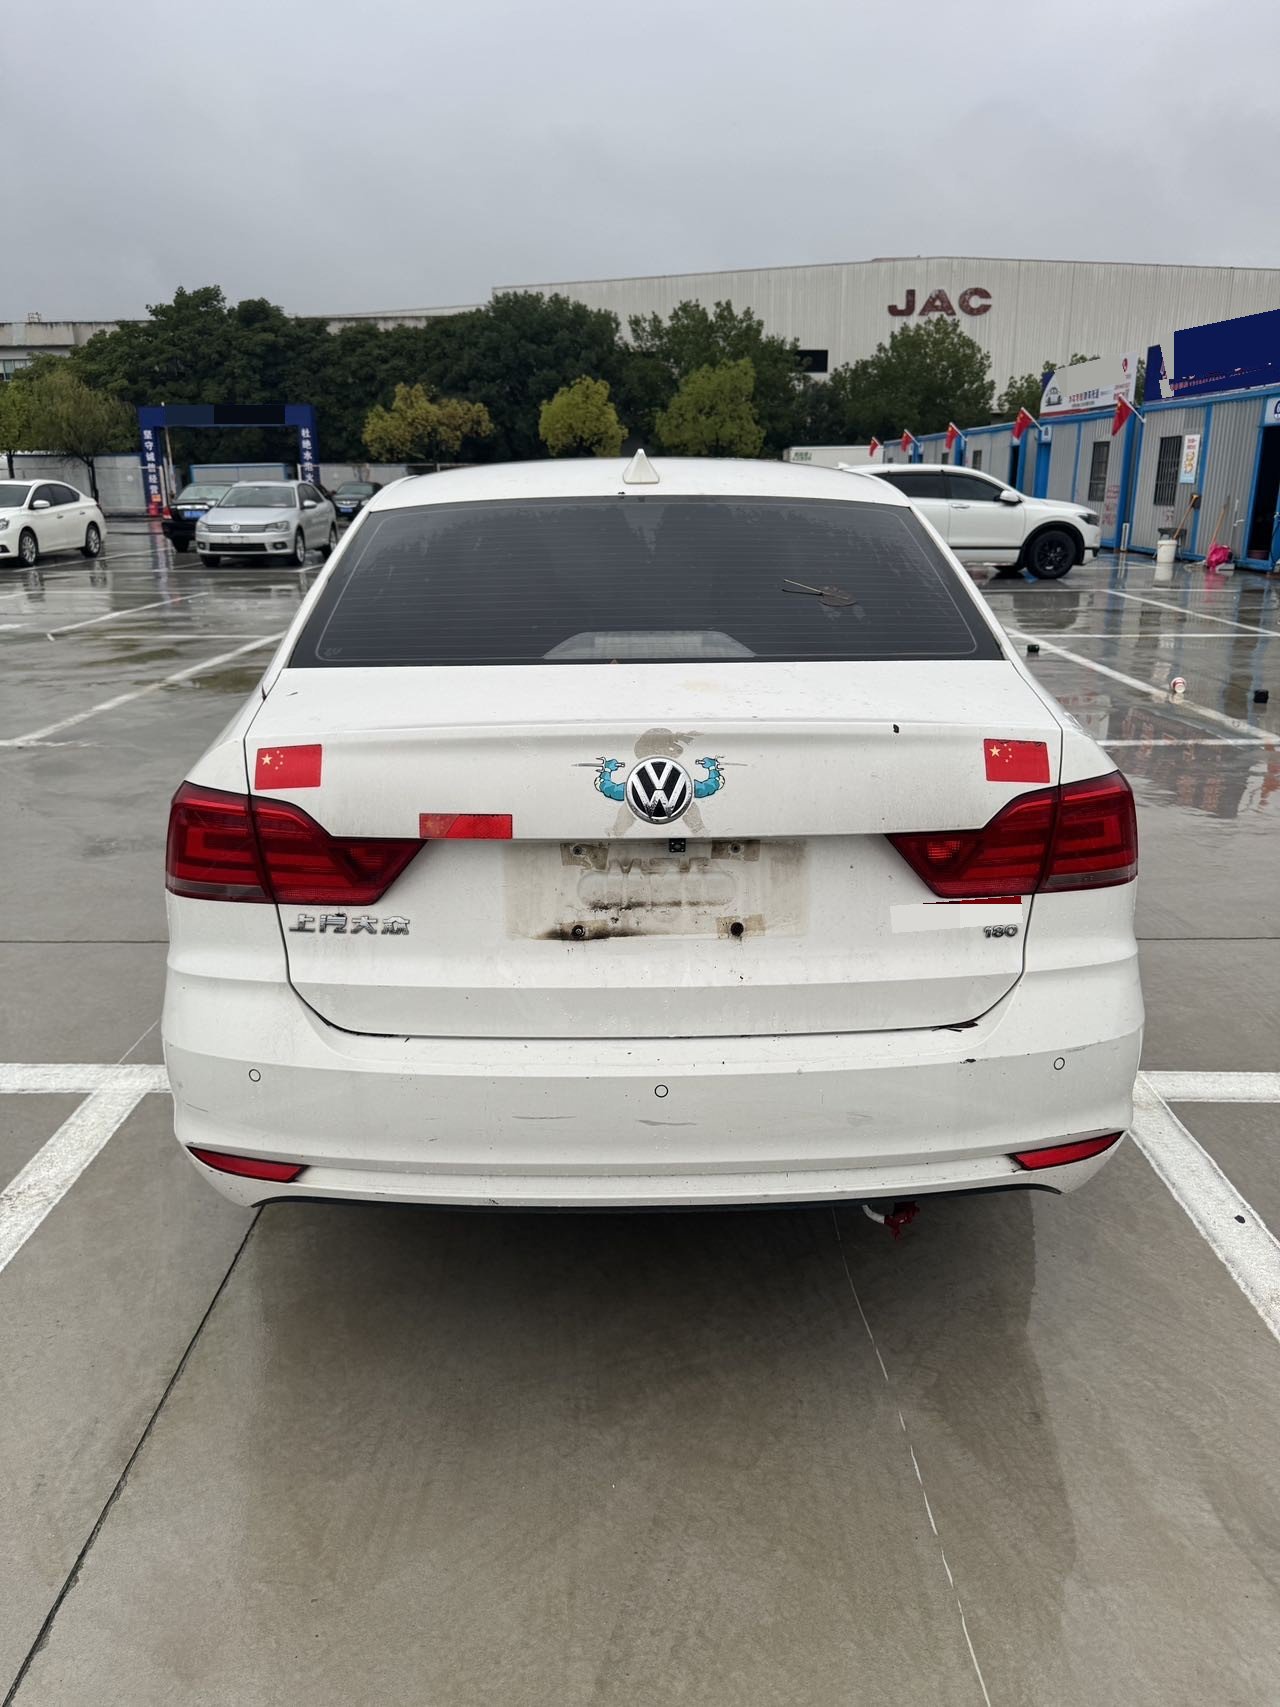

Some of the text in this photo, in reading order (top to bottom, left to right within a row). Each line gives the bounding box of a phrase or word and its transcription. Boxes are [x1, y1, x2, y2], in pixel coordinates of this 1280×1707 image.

[888, 288, 992, 316] JAC
[289, 913, 411, 935] 上汽大众
[984, 924, 1018, 938] 180
